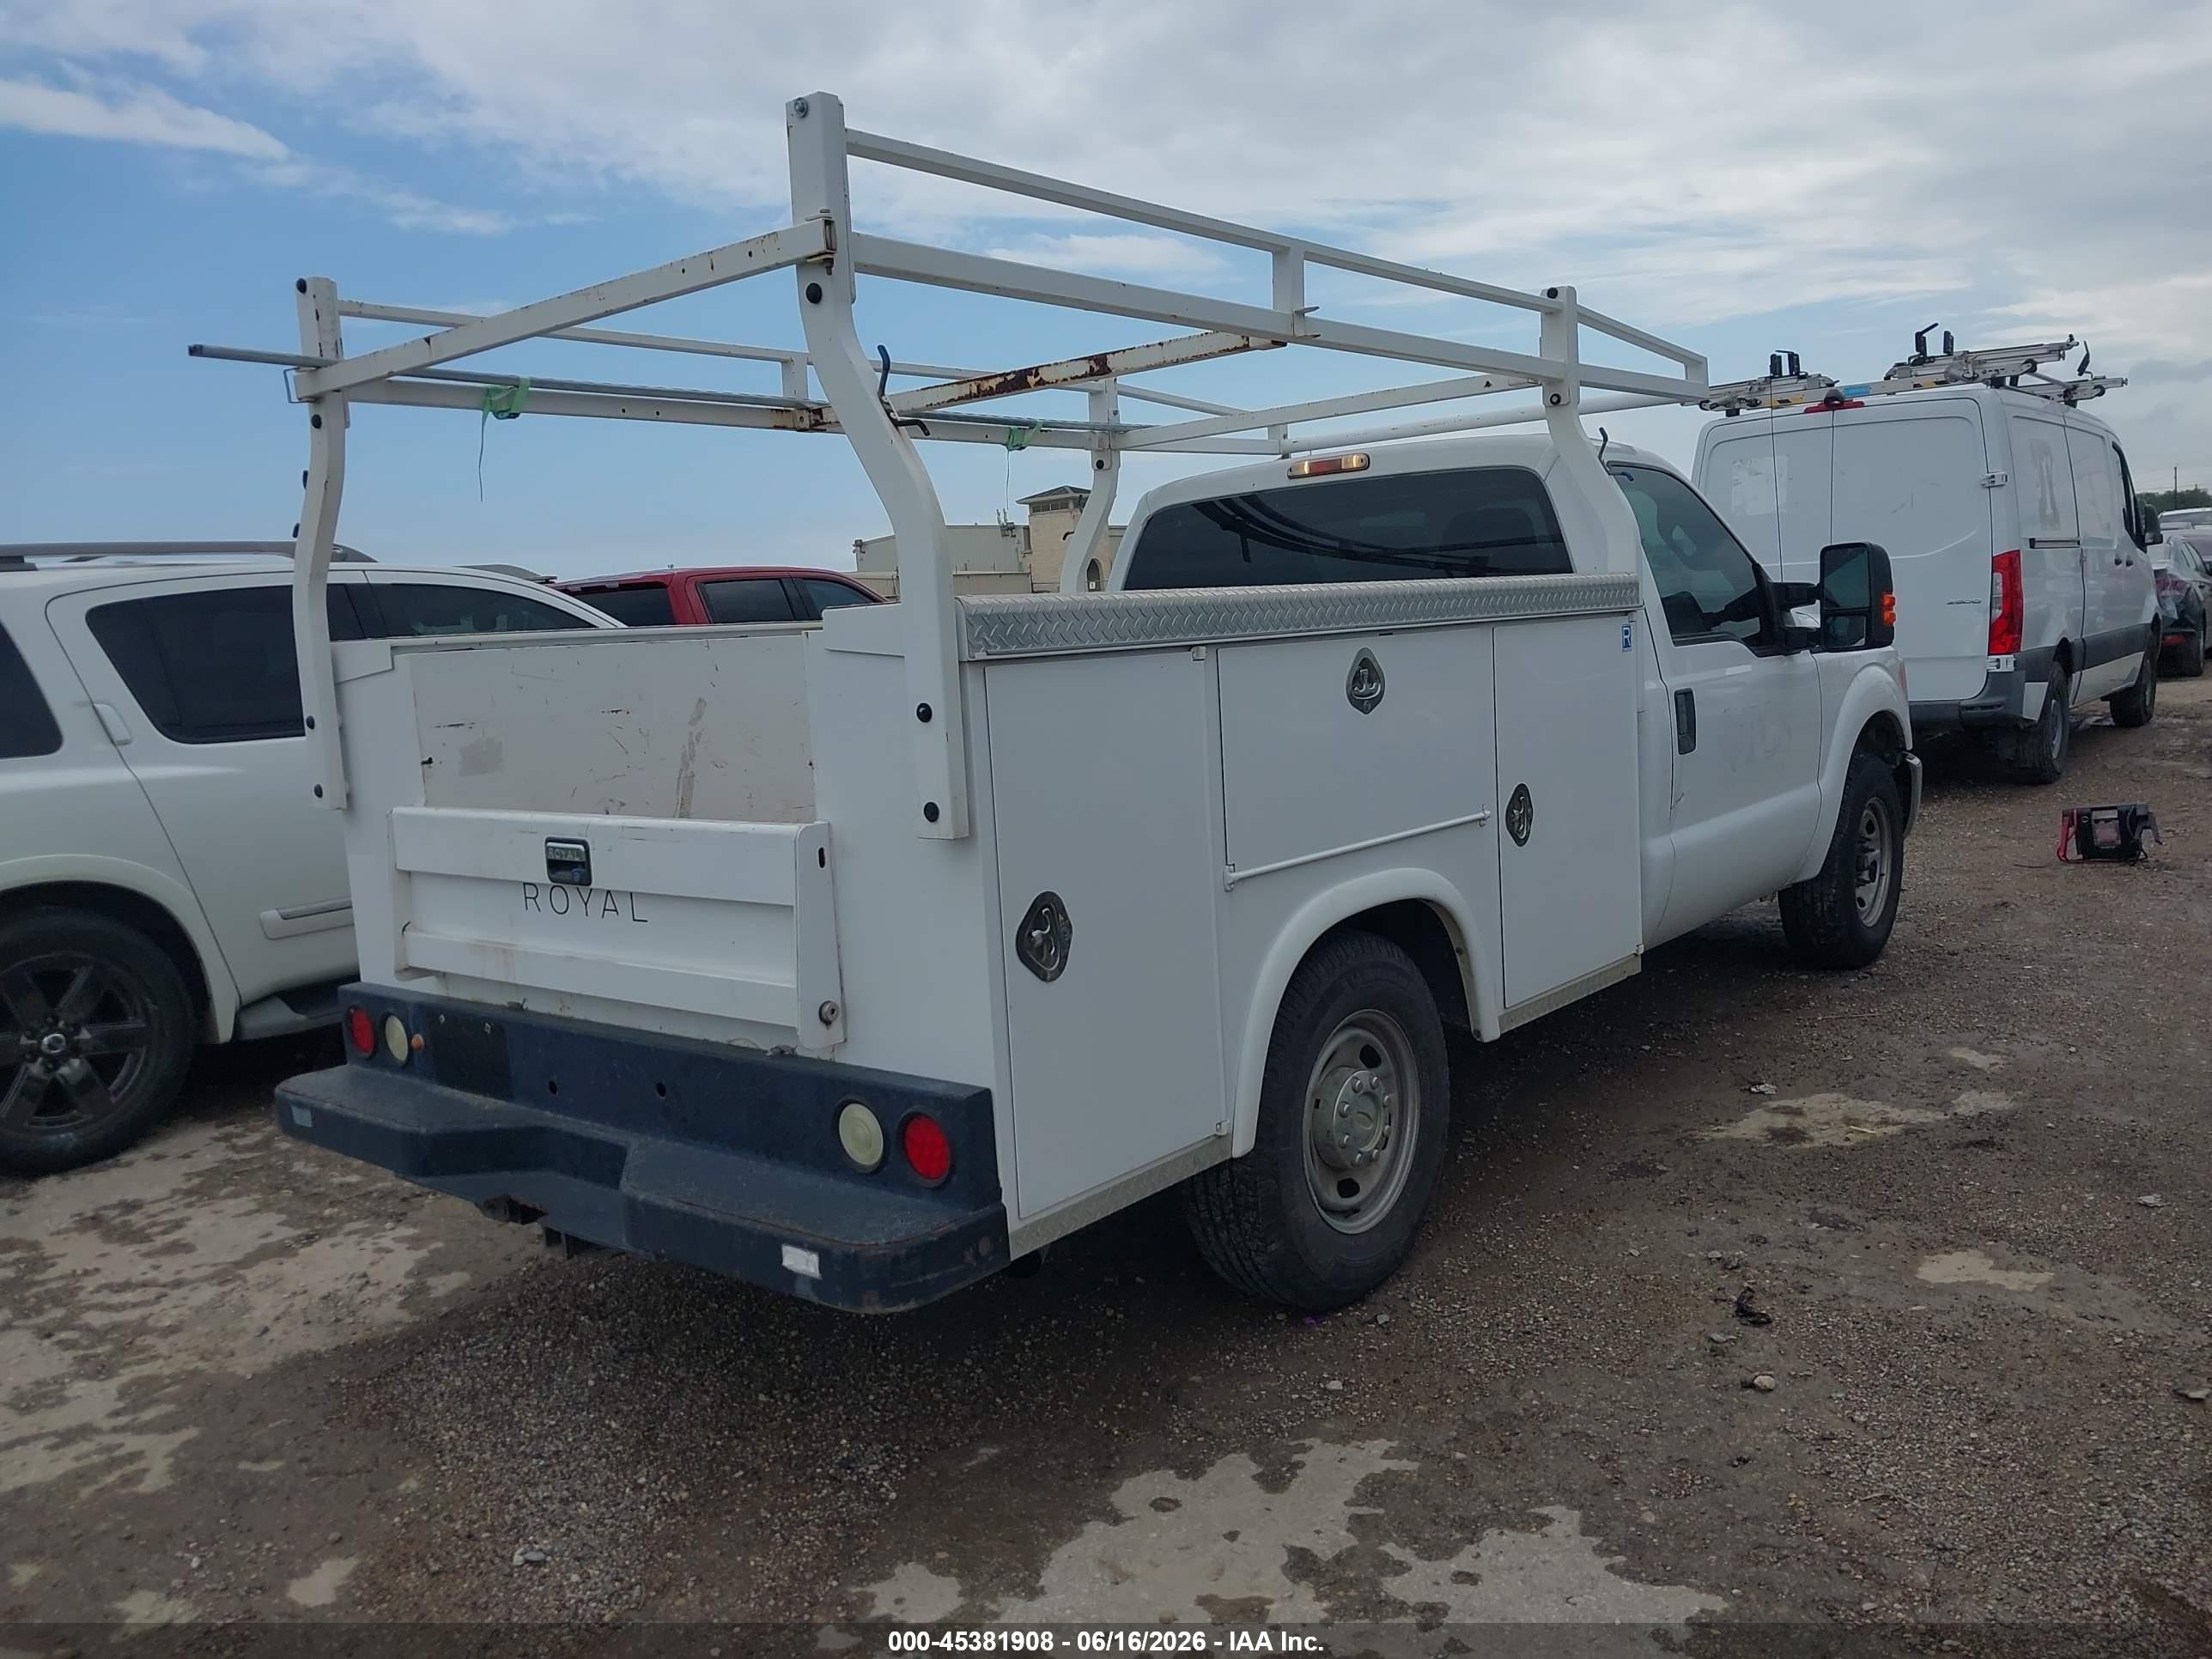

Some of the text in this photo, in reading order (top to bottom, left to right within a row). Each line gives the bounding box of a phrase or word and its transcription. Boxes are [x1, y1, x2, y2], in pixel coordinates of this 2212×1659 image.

[1622, 626, 1632, 647] R
[548, 847, 581, 861] ROYAL
[522, 882, 648, 923] ROYAL
